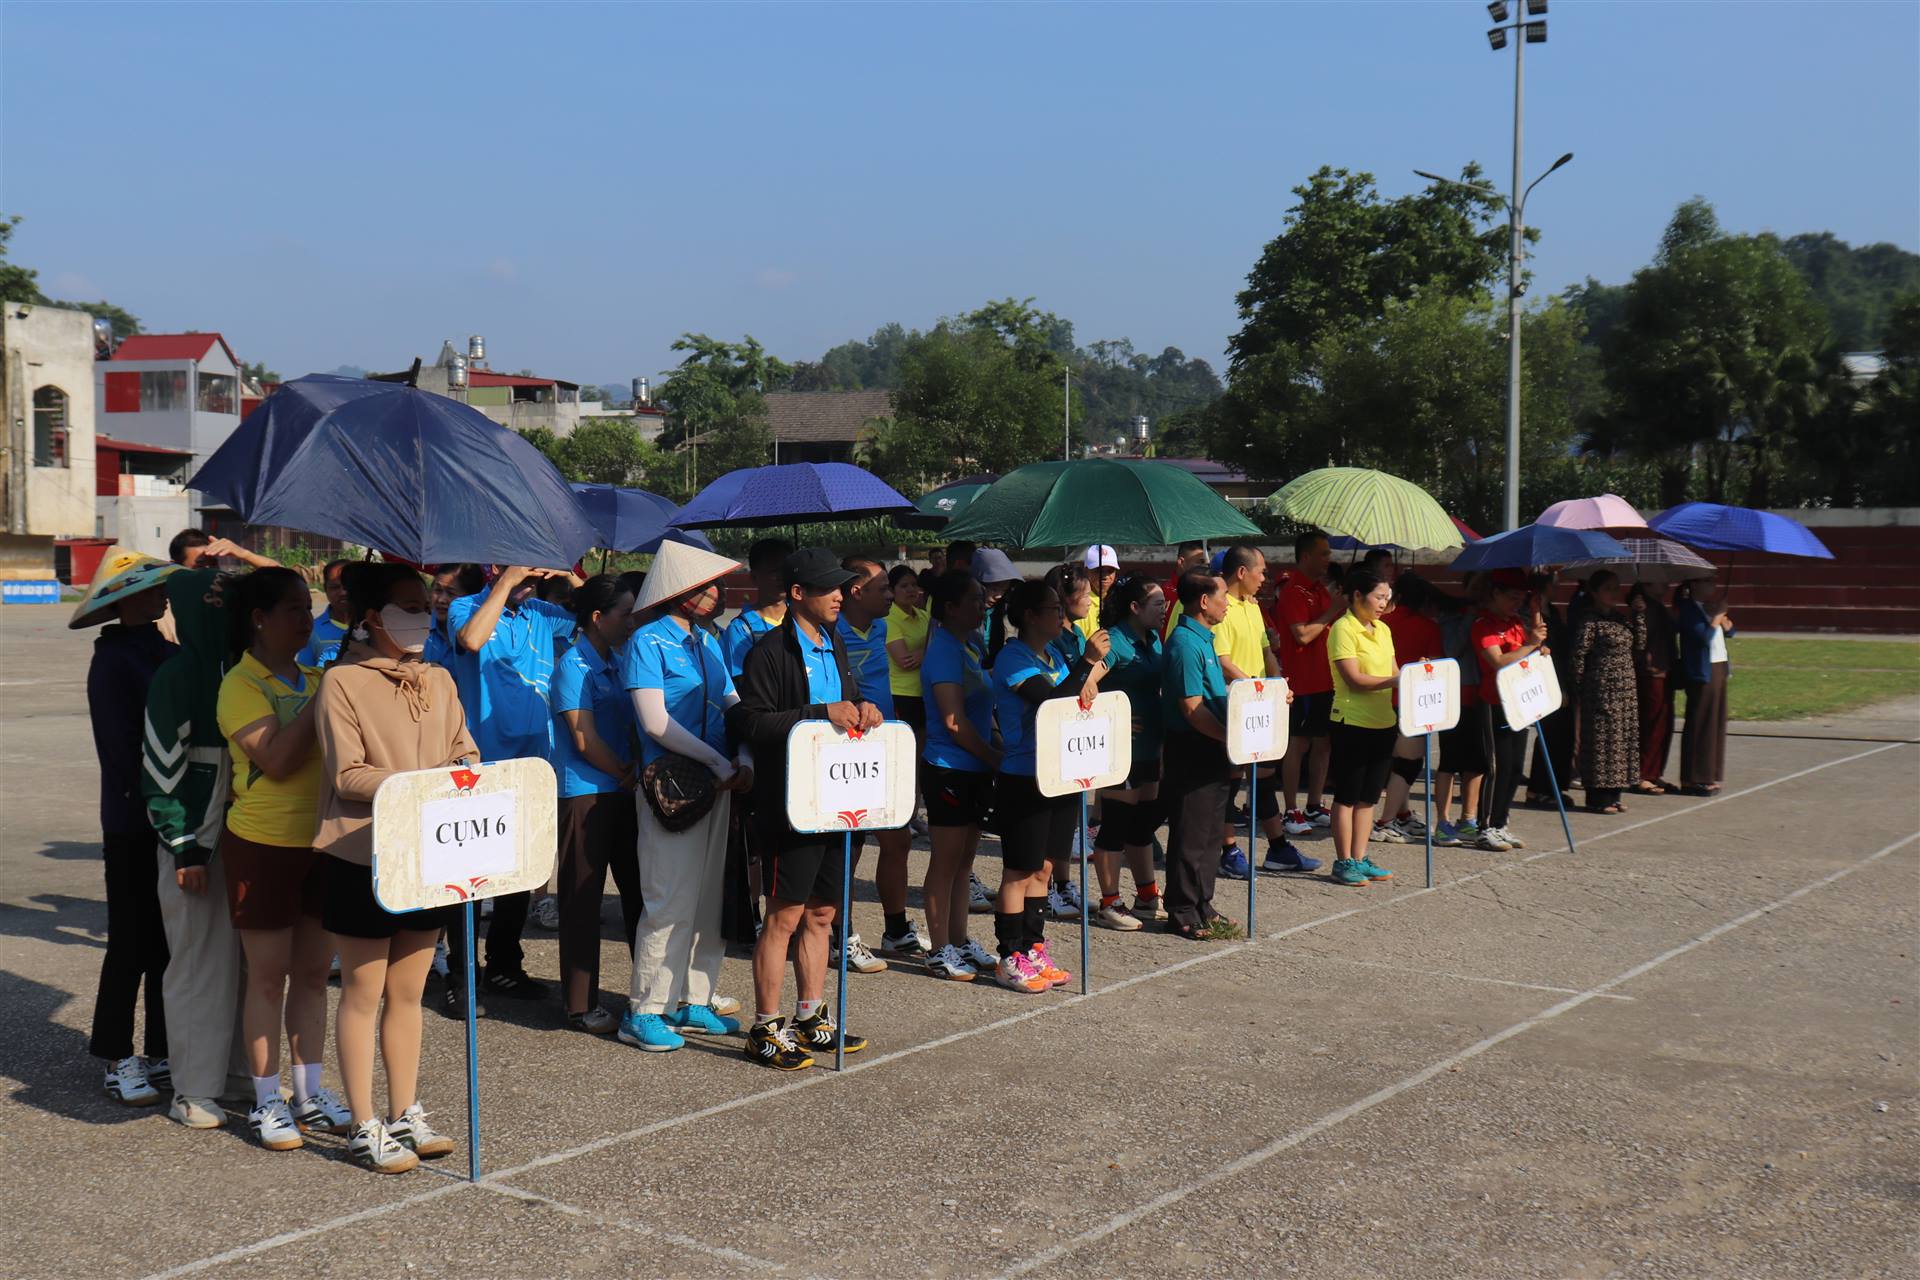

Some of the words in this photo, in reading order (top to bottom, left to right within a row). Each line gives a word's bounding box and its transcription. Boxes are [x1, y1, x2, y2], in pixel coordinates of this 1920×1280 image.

[1418, 693, 1436, 709] CỤM
[1245, 715, 1264, 733] CỤM
[1265, 714, 1270, 728] 3
[1067, 735, 1096, 756] CỤM
[1099, 734, 1105, 749] 4
[829, 762, 866, 784] CỤM
[871, 761, 879, 778] 5
[435, 818, 488, 847] CỤM
[496, 814, 506, 836] 6
